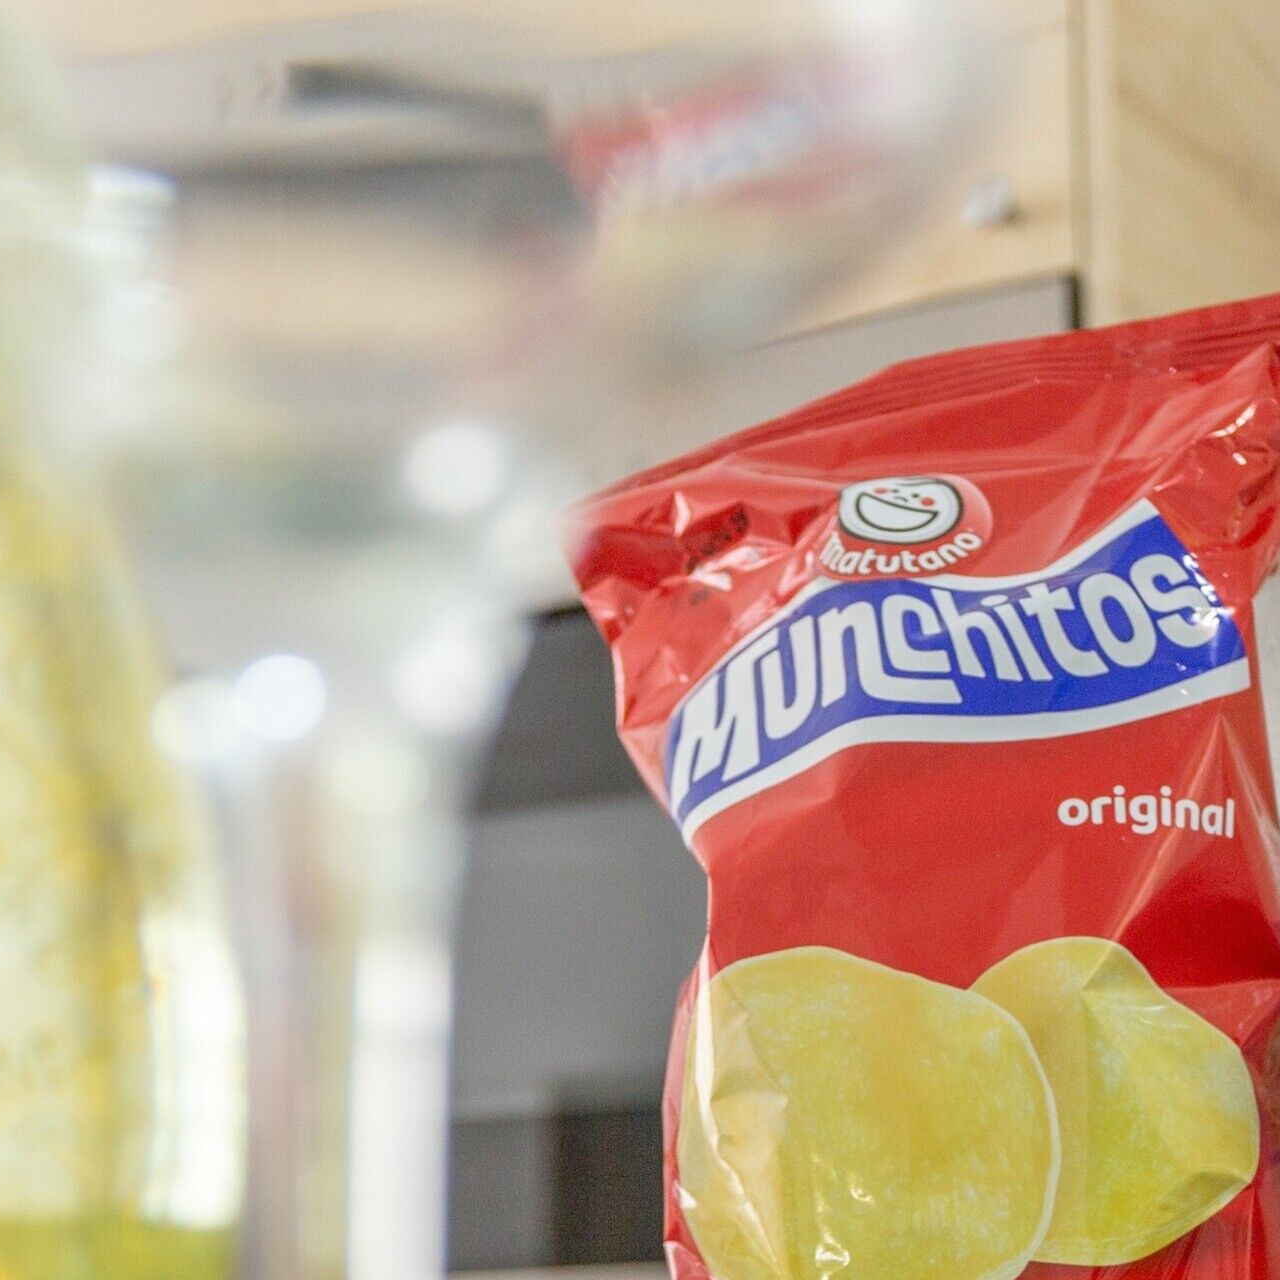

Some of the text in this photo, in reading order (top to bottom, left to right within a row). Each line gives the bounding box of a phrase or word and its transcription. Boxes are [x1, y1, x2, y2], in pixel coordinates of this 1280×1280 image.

[820, 530, 983, 575] matutano
[670, 552, 1220, 803] Munchitos
[1057, 785, 1235, 838] original
